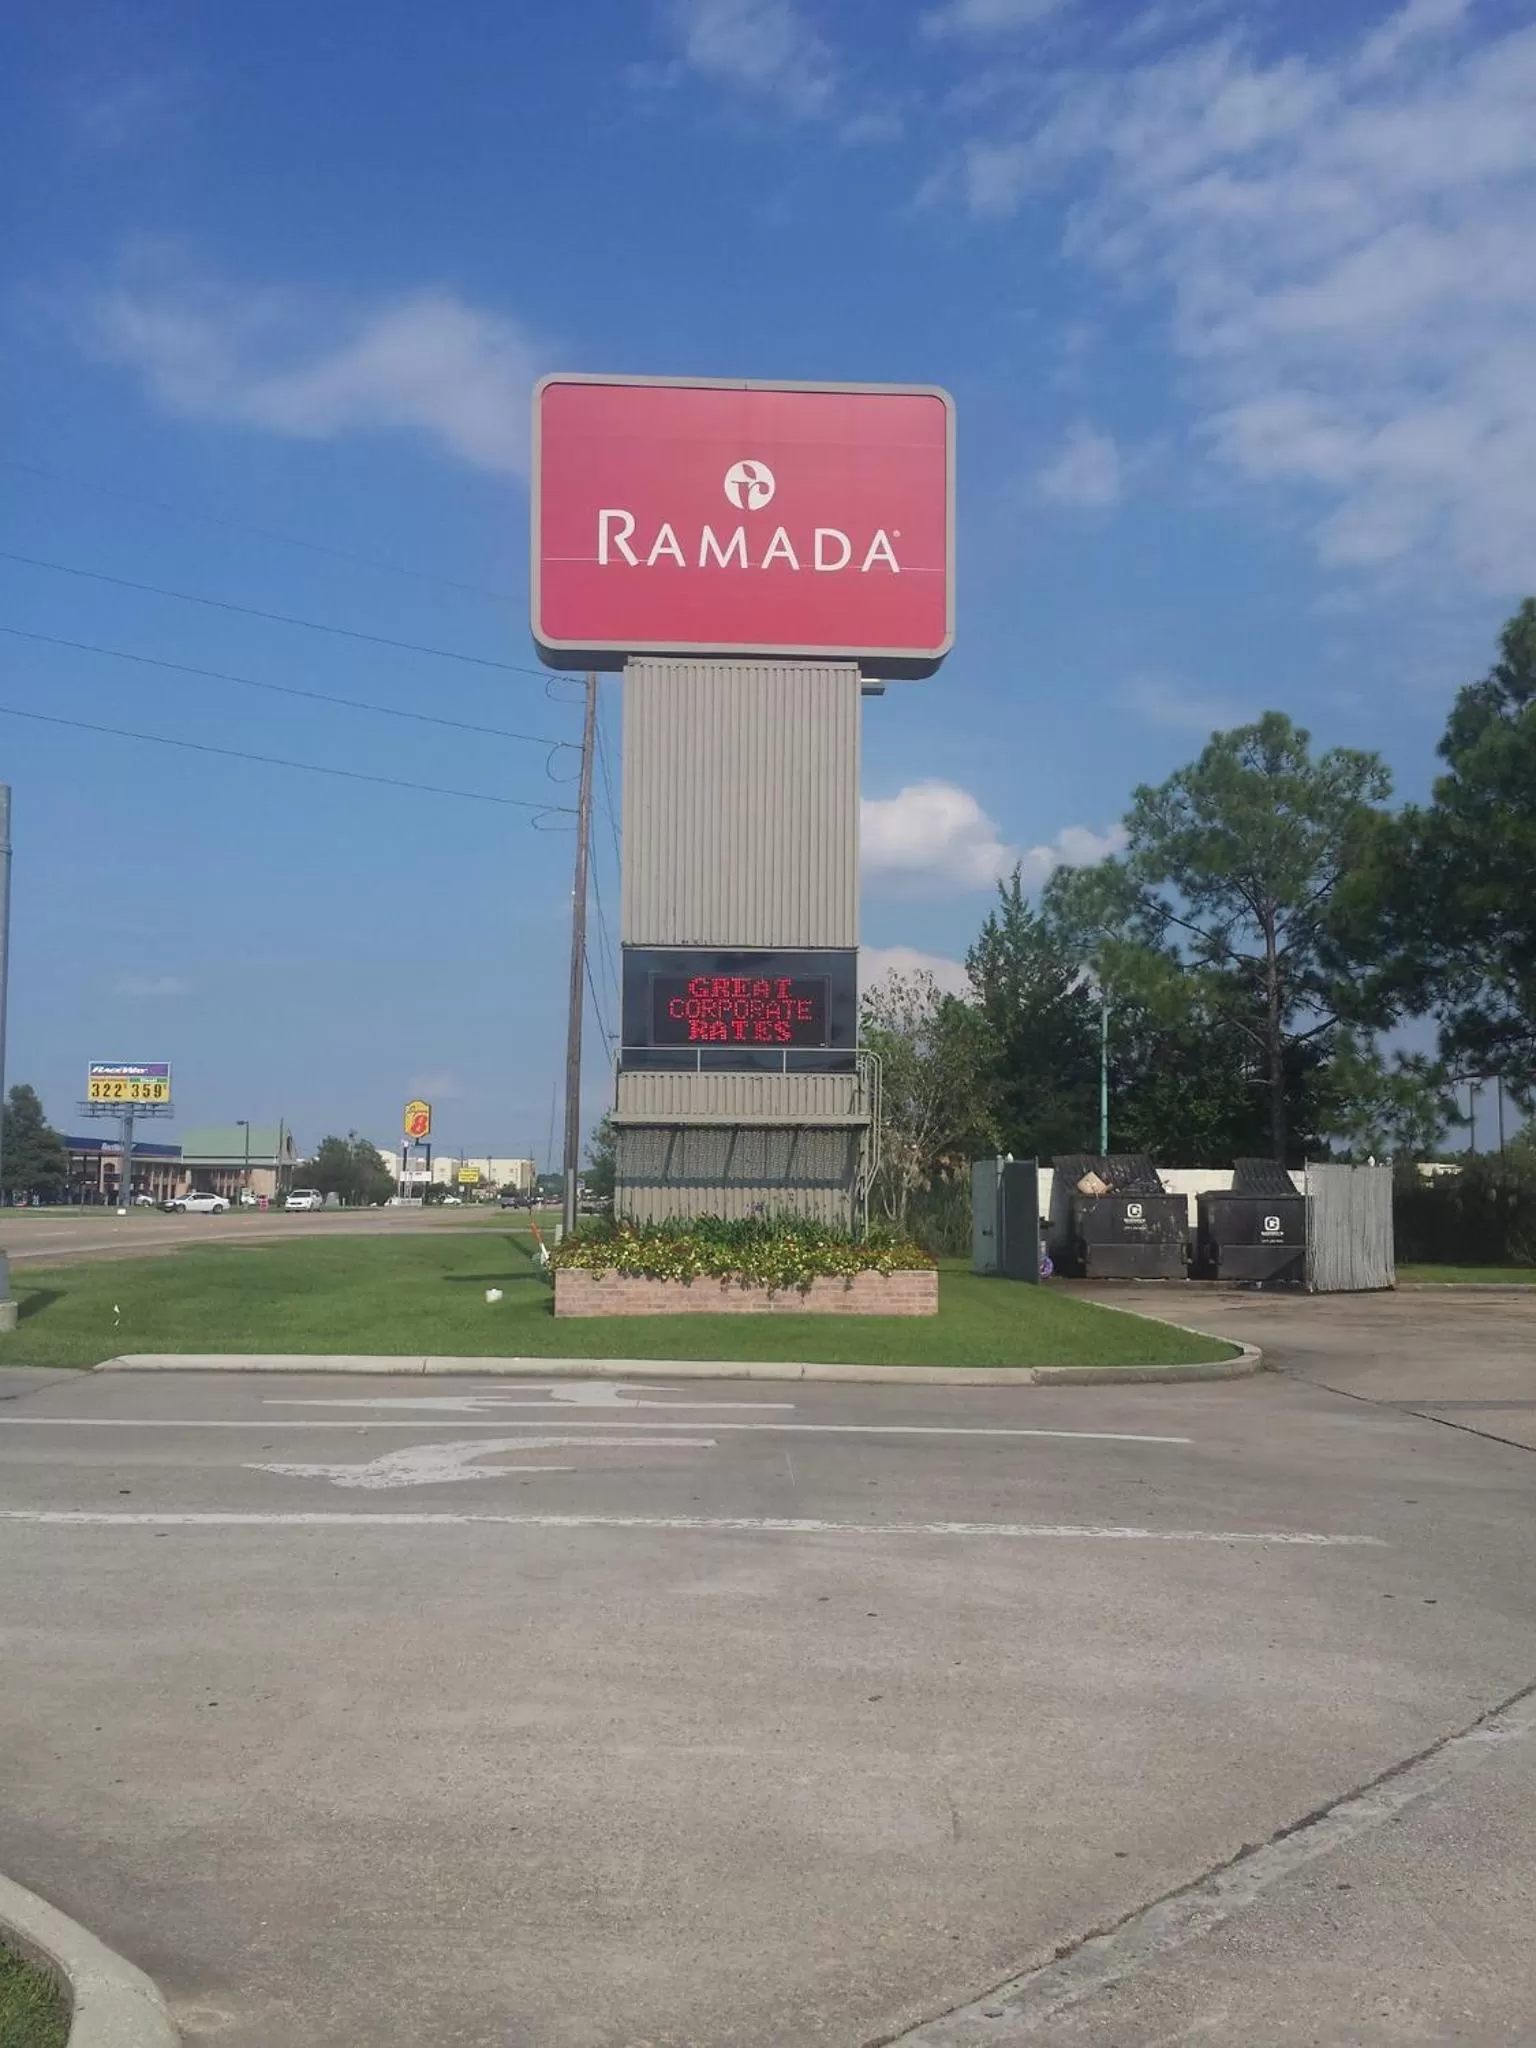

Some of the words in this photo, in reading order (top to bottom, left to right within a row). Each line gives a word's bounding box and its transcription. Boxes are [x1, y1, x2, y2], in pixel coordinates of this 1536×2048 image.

[598, 508, 901, 573] RAMADA
[688, 977, 792, 998] GREAT
[668, 999, 812, 1020] CORPORATE
[688, 1020, 792, 1041] RATES
